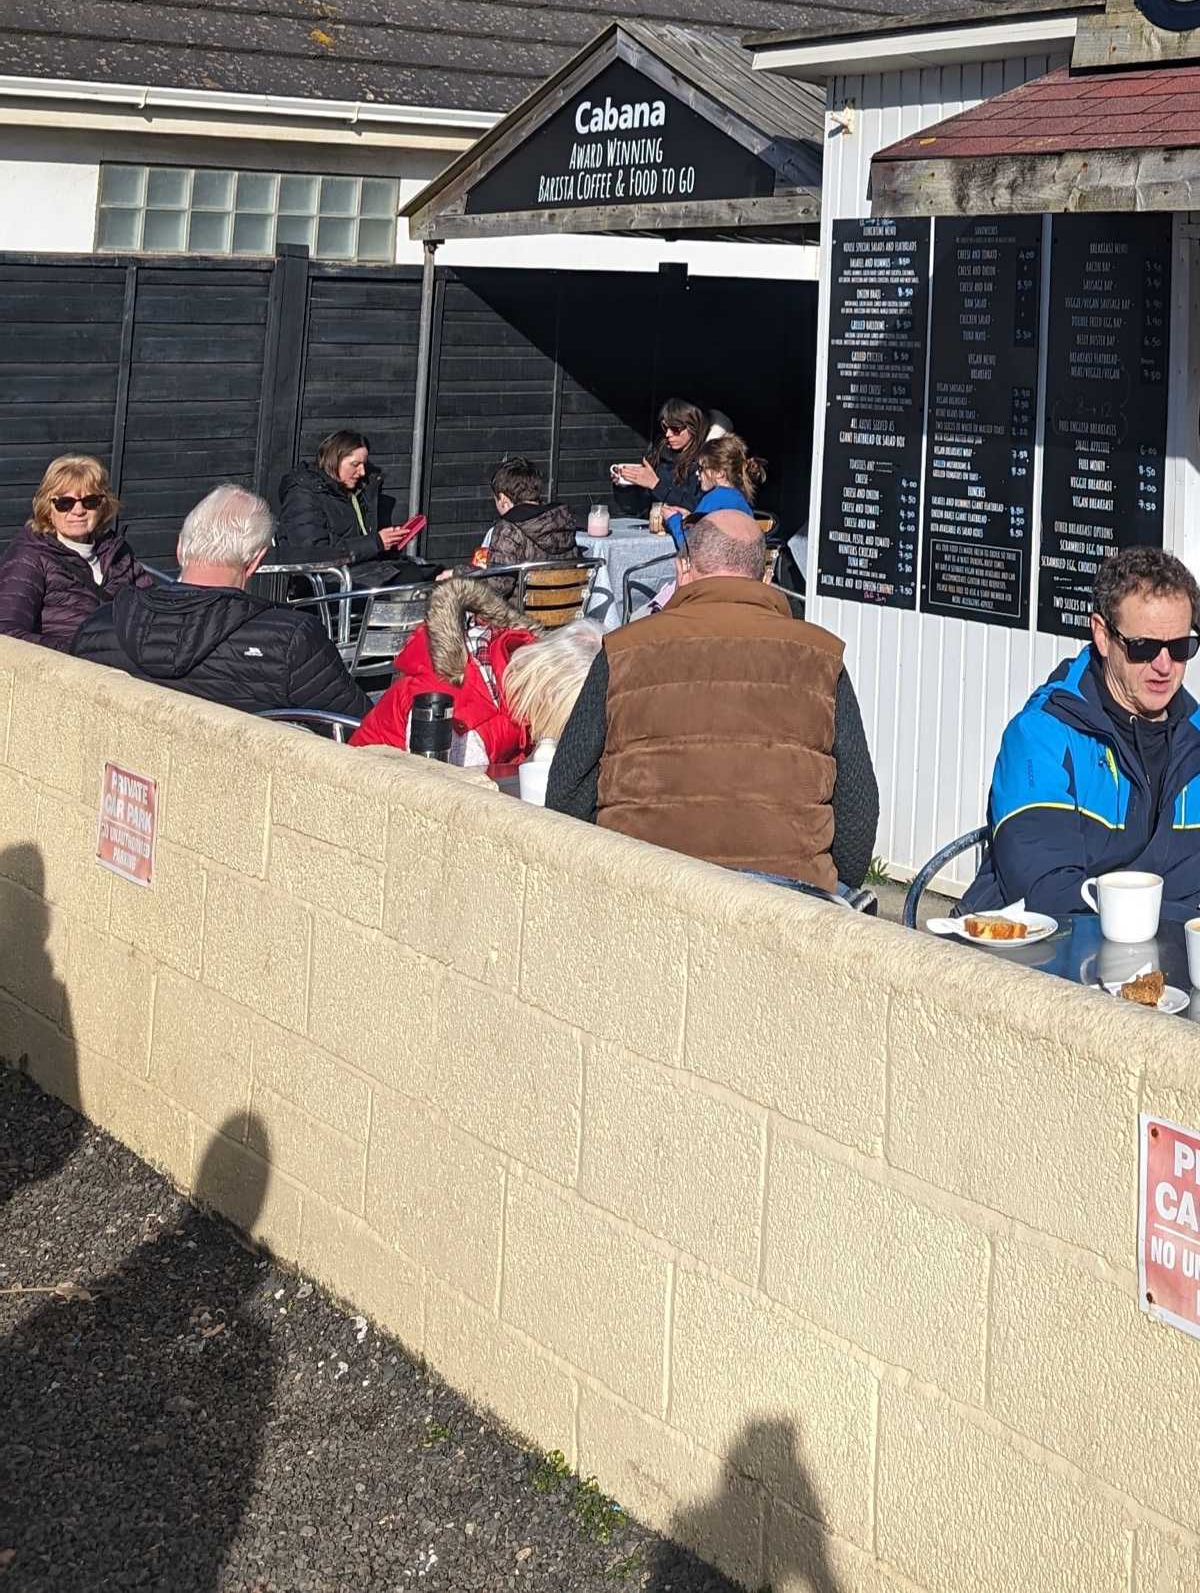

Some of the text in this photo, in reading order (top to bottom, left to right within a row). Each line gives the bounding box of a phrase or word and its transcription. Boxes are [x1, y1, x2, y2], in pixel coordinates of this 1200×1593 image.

[575, 97, 666, 134] Cabana
[569, 137, 663, 170] AWARD WINNING
[538, 166, 695, 203] BARISTA COFFEE & FOOD TO GO
[1150, 1235, 1175, 1269] NO
